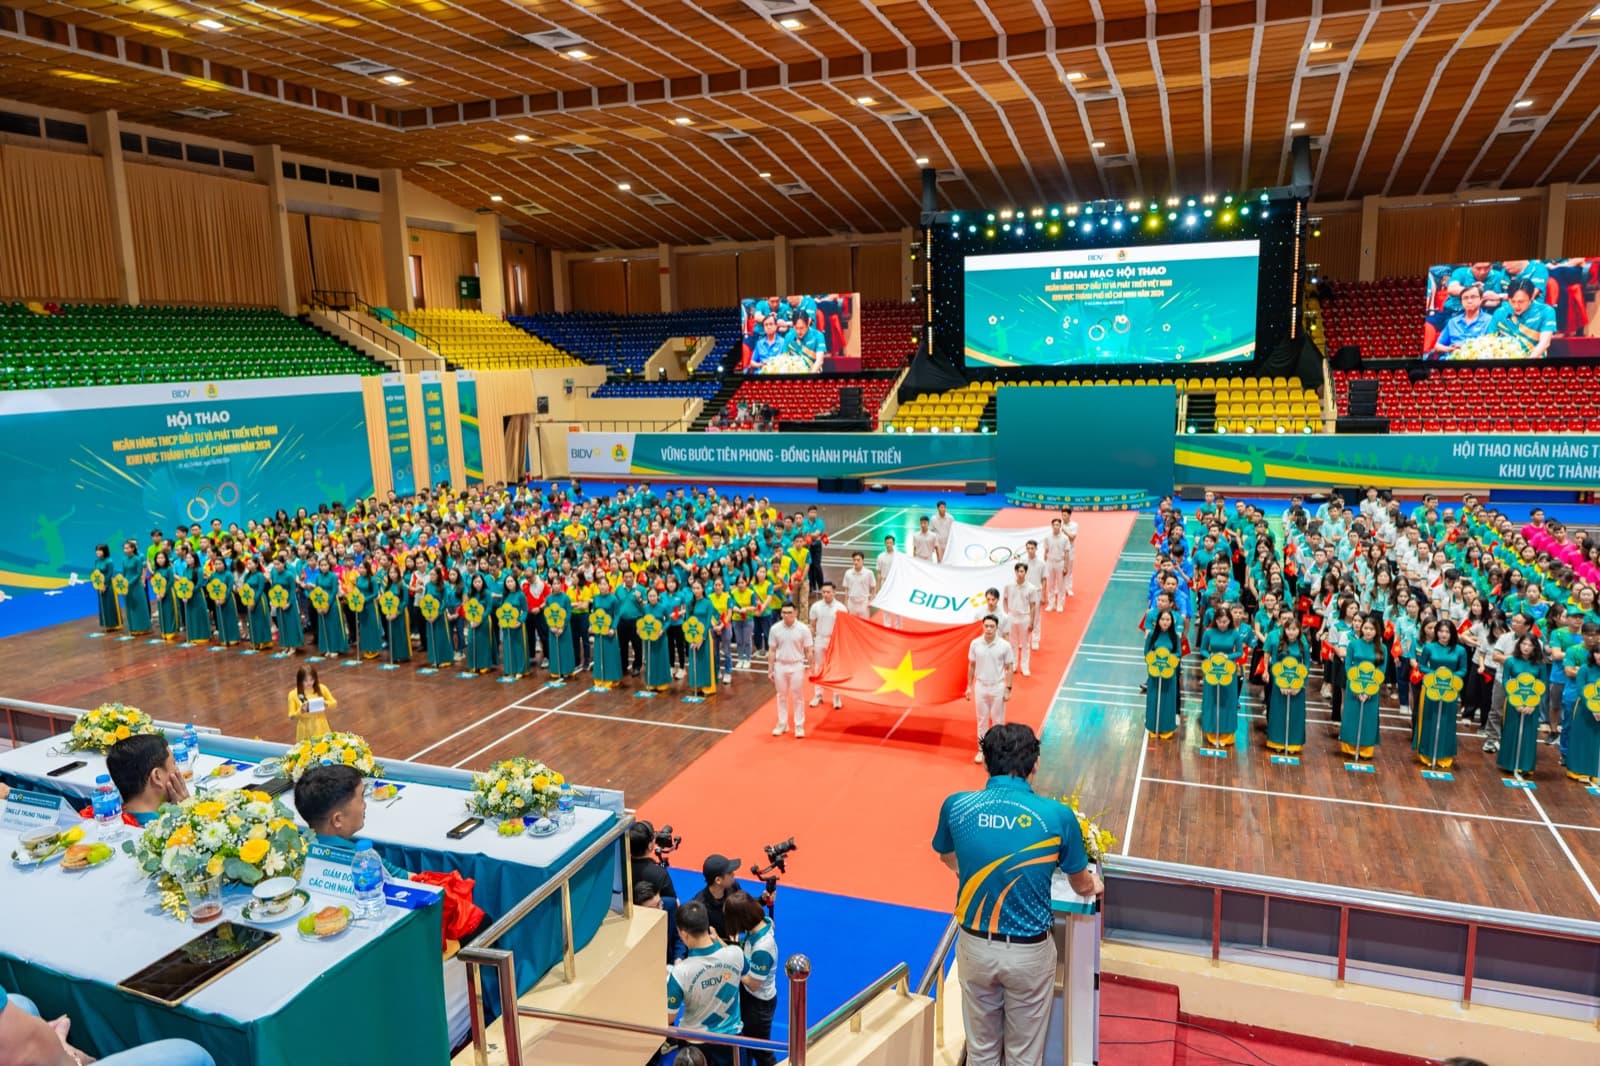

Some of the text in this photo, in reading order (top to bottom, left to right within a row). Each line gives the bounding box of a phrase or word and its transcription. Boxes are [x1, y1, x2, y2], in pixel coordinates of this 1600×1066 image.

[1063, 270, 1088, 280] KHAI
[1090, 269, 1114, 280] MẠC
[1116, 265, 1135, 279] HỘI
[1137, 266, 1166, 275] THAO
[172, 390, 191, 398] BIDV
[166, 410, 230, 429] HỘI THAO
[571, 448, 592, 458] BIDV
[661, 446, 687, 462] VỮNG
[688, 445, 714, 462] BƯỚC
[716, 446, 737, 462] TIÊN
[740, 448, 774, 462] PHONG
[780, 445, 810, 462] ĐỒNG
[812, 446, 840, 463] HÀNH
[842, 447, 868, 464] PHÁT
[871, 446, 902, 464] TRIỂN
[1453, 440, 1600, 459] HỘI THAO NGÂN HÀNG T
[1499, 462, 1600, 480] KHU VỰC THÀNH
[909, 589, 970, 611] BIDV
[978, 813, 1017, 830] BIDV
[324, 881, 336, 890] CHI
[701, 975, 722, 989] BIDV
